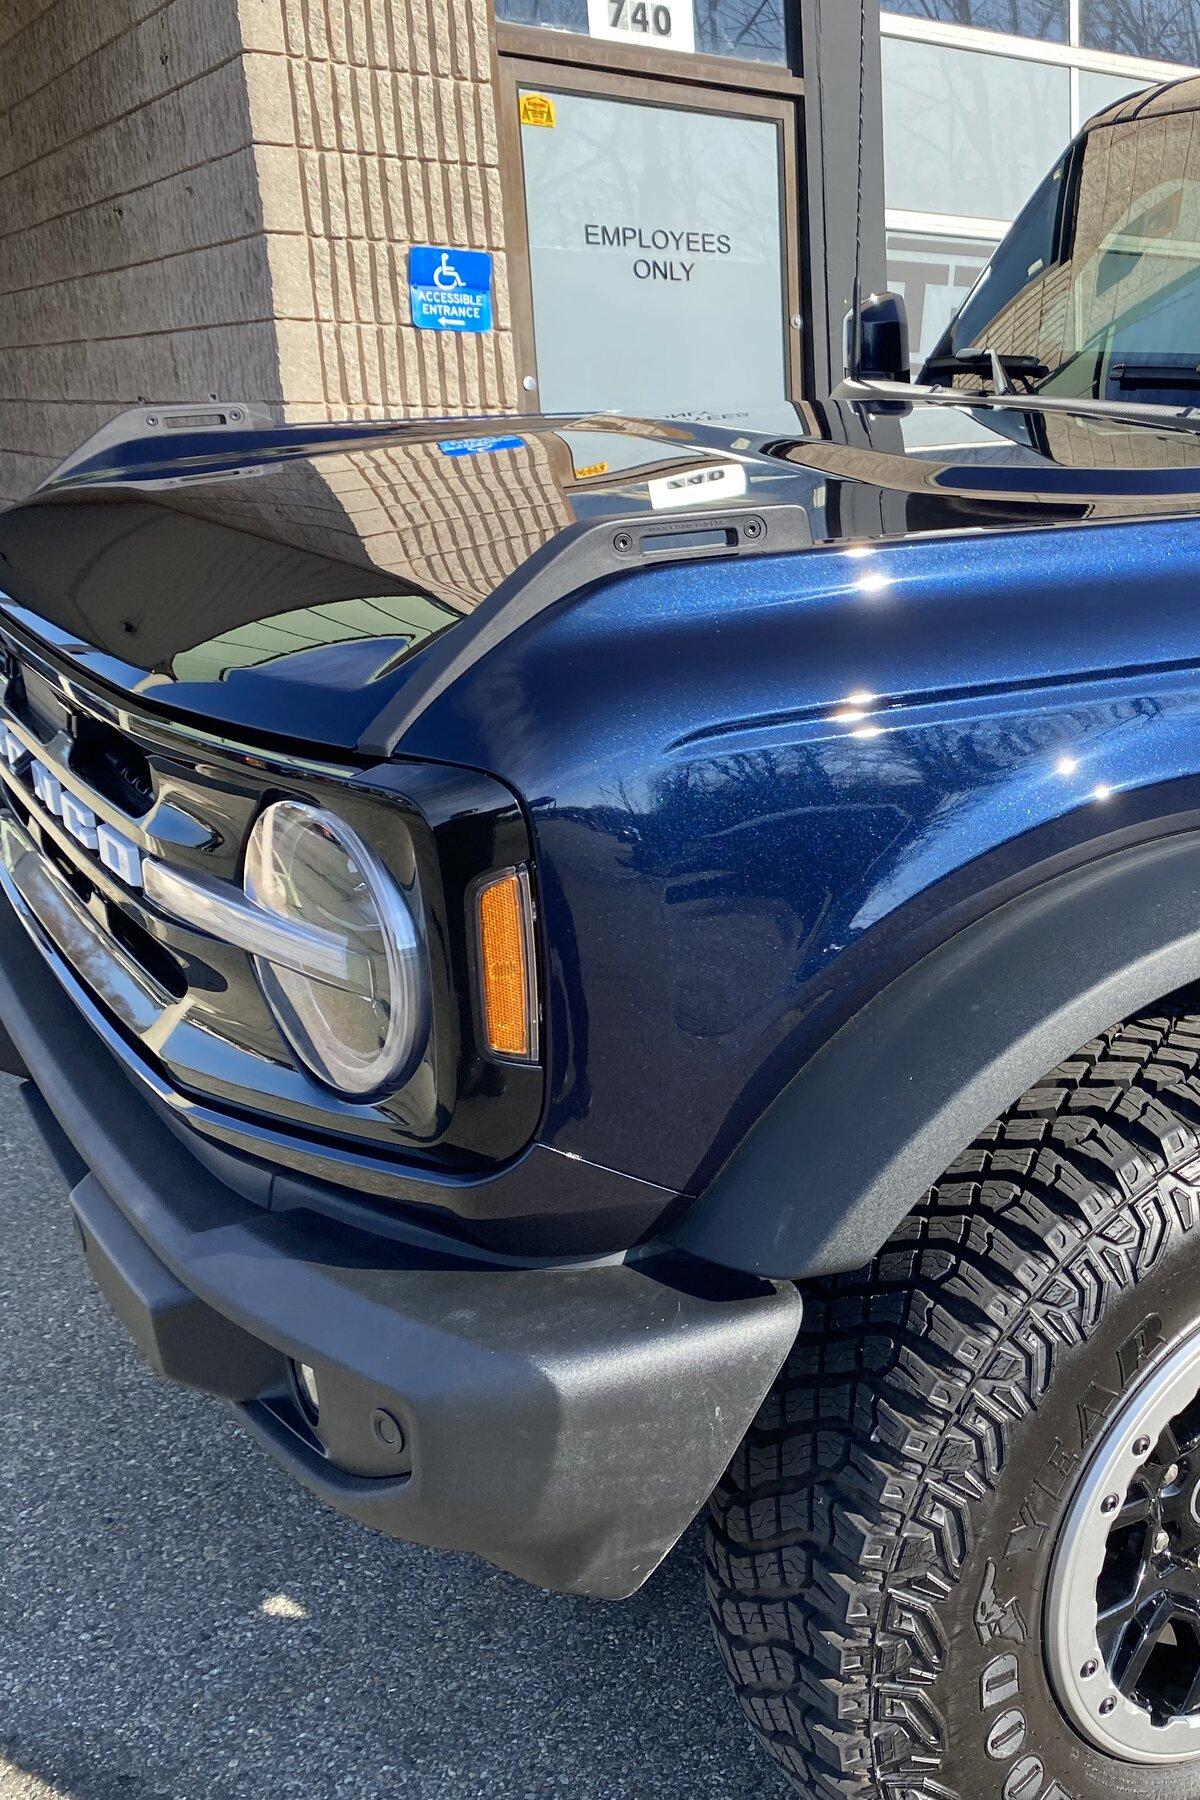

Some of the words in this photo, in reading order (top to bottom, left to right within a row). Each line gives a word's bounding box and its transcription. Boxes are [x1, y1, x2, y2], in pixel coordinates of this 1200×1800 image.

[607, 0, 672, 36] 740
[584, 224, 731, 254] EMPLOYEES
[633, 258, 696, 282] ONLY
[418, 290, 483, 306] ACCESSIBLE
[422, 303, 481, 319] ENTRANCE
[981, 1650, 1078, 1800] OOD
